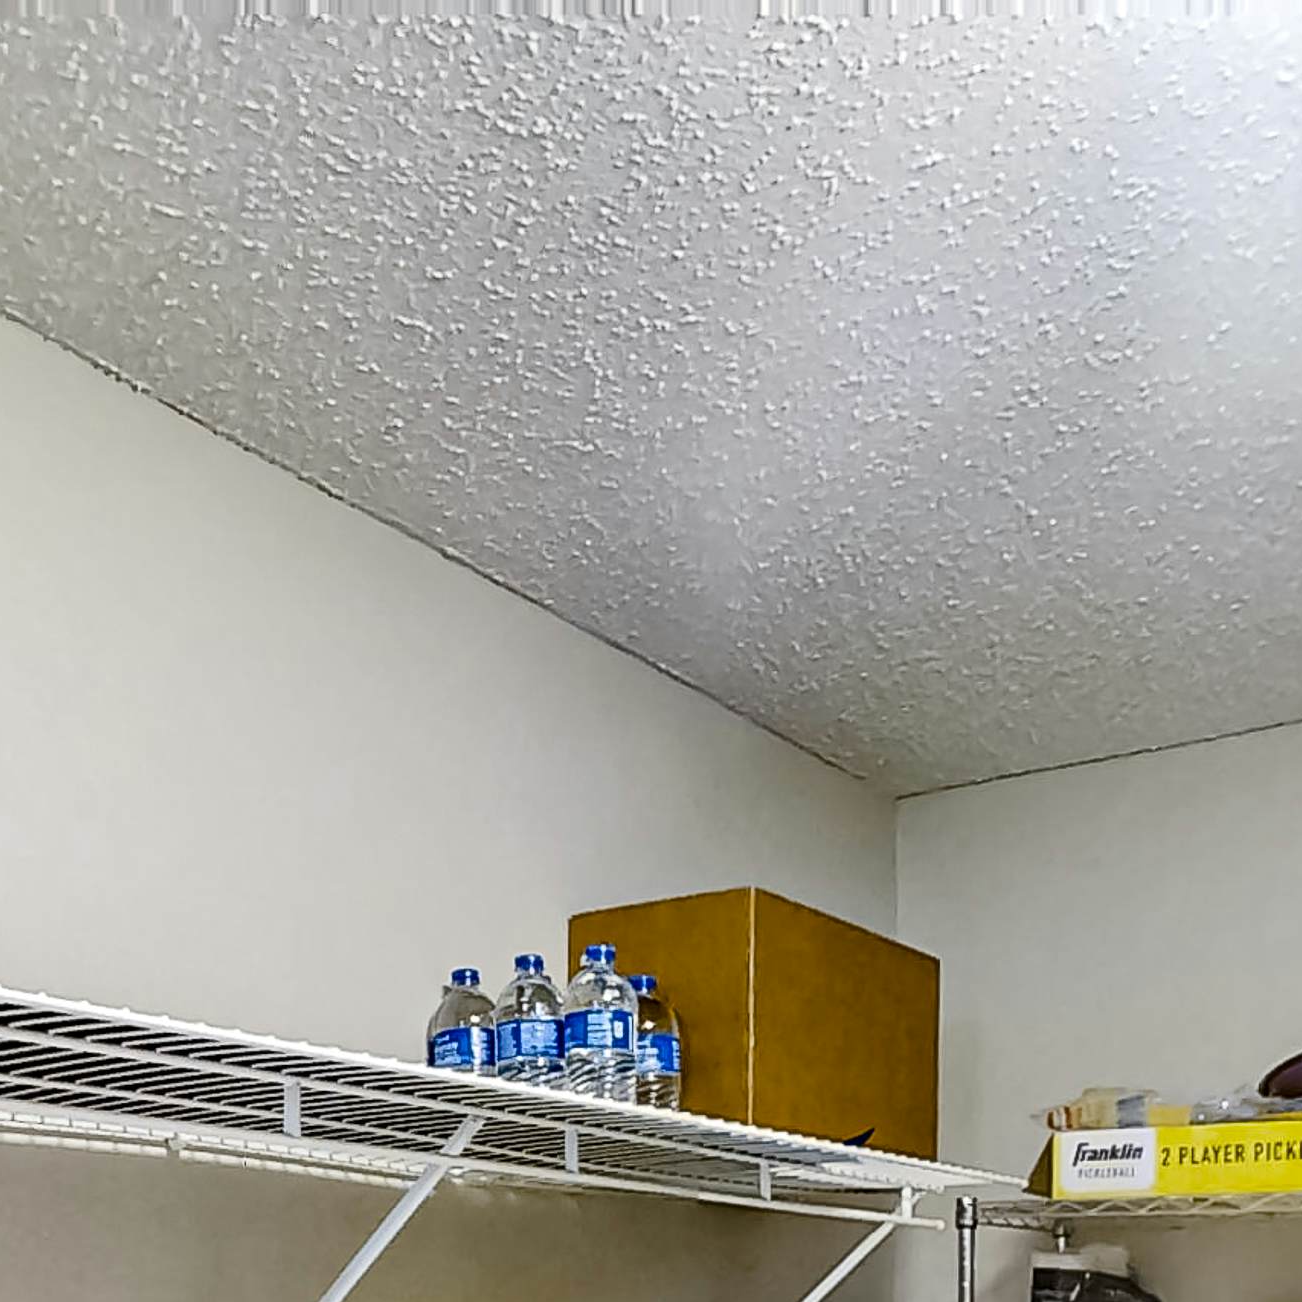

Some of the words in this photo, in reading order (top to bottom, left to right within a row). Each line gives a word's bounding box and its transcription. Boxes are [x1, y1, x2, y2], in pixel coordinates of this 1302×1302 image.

[1072, 1142, 1144, 1167] Franklin
[1161, 1147, 1171, 1167] 2
[1178, 1143, 1246, 1166] PLAYER
